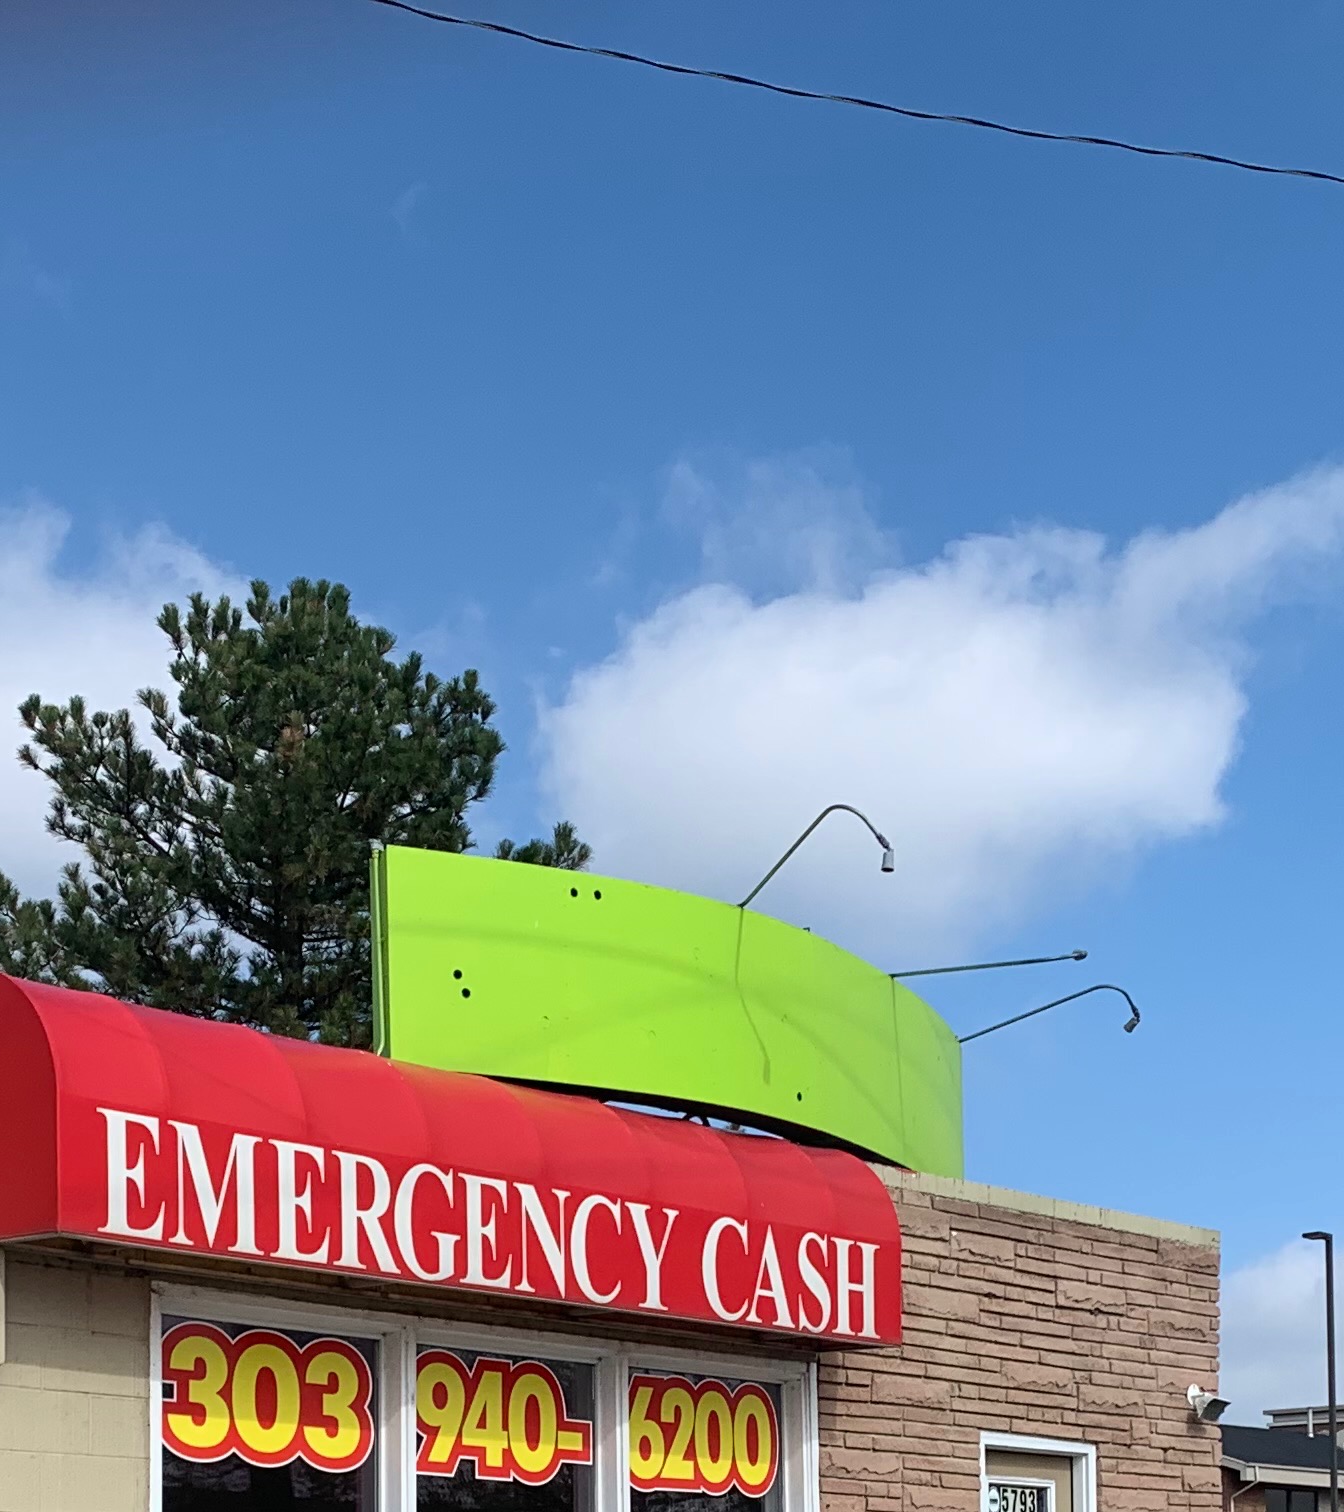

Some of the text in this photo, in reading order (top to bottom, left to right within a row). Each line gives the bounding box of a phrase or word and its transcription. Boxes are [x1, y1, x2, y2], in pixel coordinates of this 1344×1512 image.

[95, 1107, 881, 1340] EMERGENCY CASH
[166, 1335, 772, 1486] 303 940- 6200
